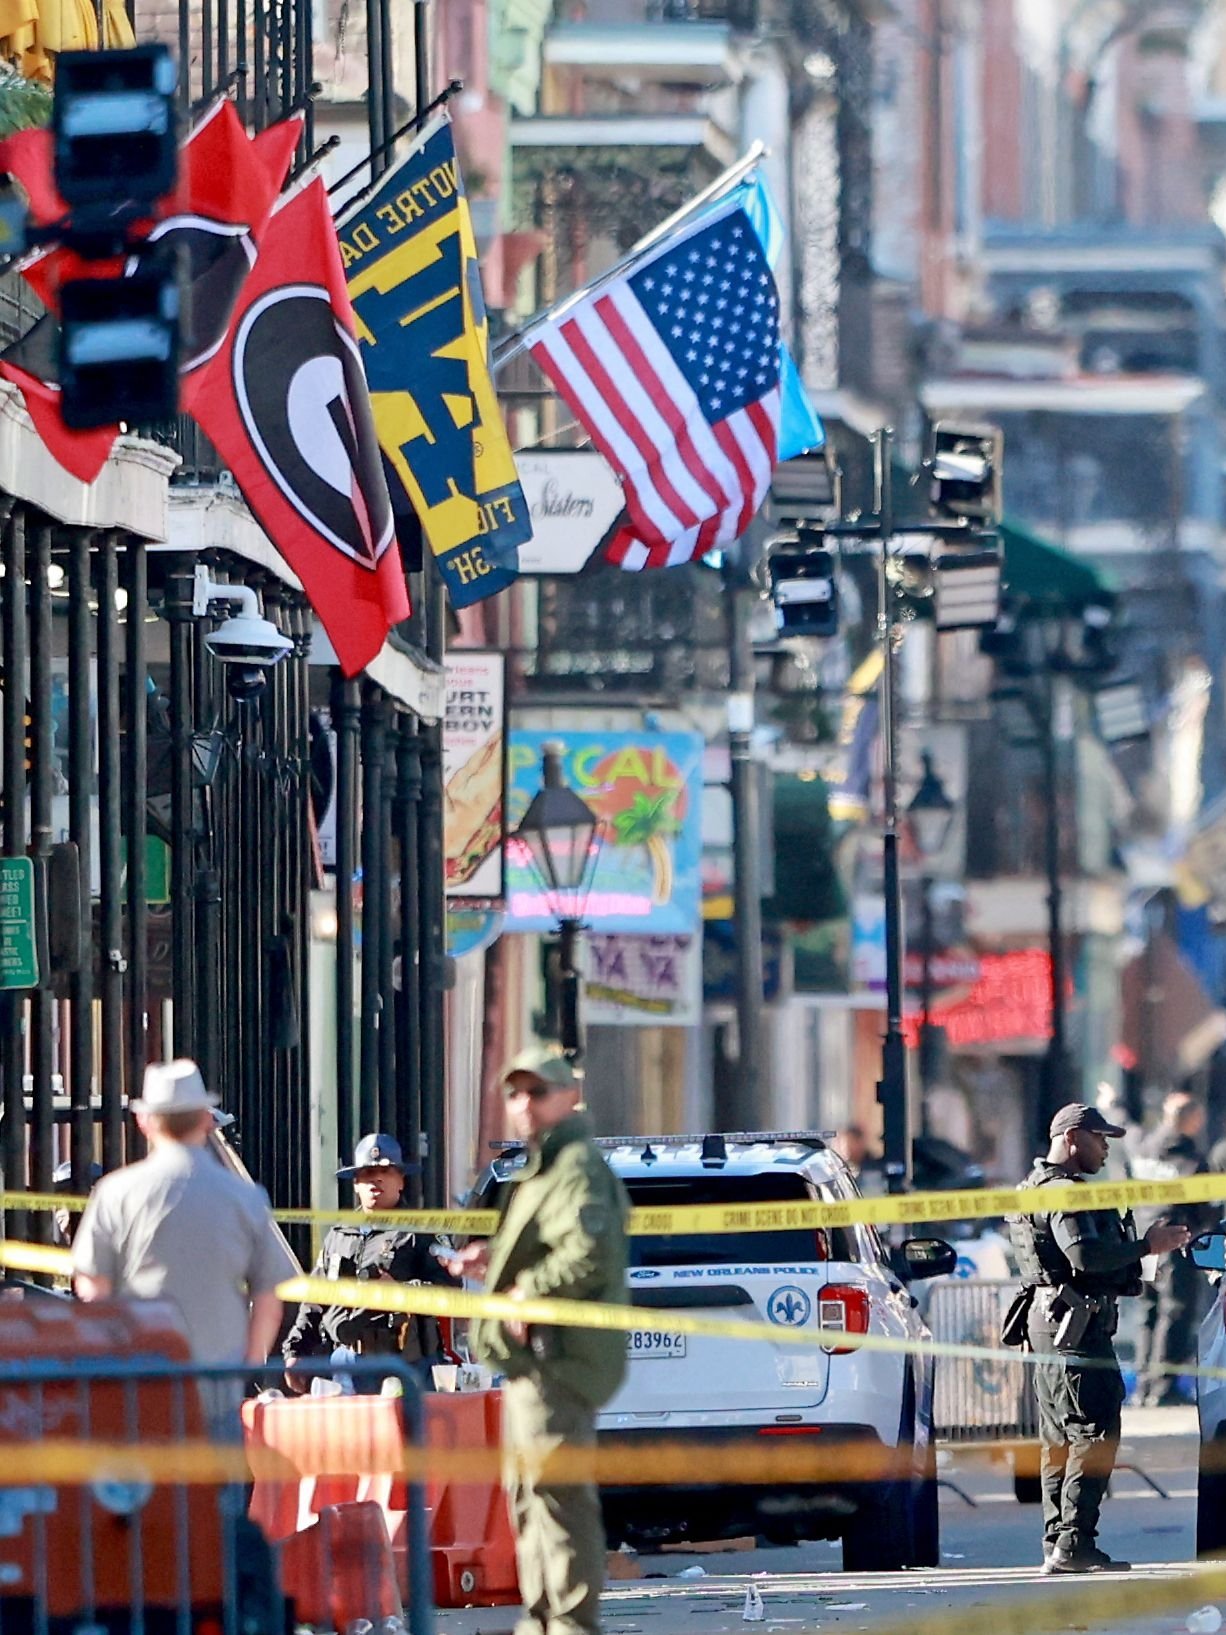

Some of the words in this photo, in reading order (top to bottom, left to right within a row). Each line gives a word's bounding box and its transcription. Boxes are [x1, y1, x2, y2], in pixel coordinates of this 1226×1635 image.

[531, 478, 595, 521] Sisters
[509, 744, 684, 787] PCAL
[723, 1210, 751, 1227] CRIME
[755, 1209, 783, 1226] SCENE
[786, 1209, 798, 1225] DO
[801, 1208, 817, 1224] NOT
[673, 1270, 704, 1278] NEW
[707, 1268, 771, 1276] ORLEANS
[773, 1267, 819, 1275] POLICE
